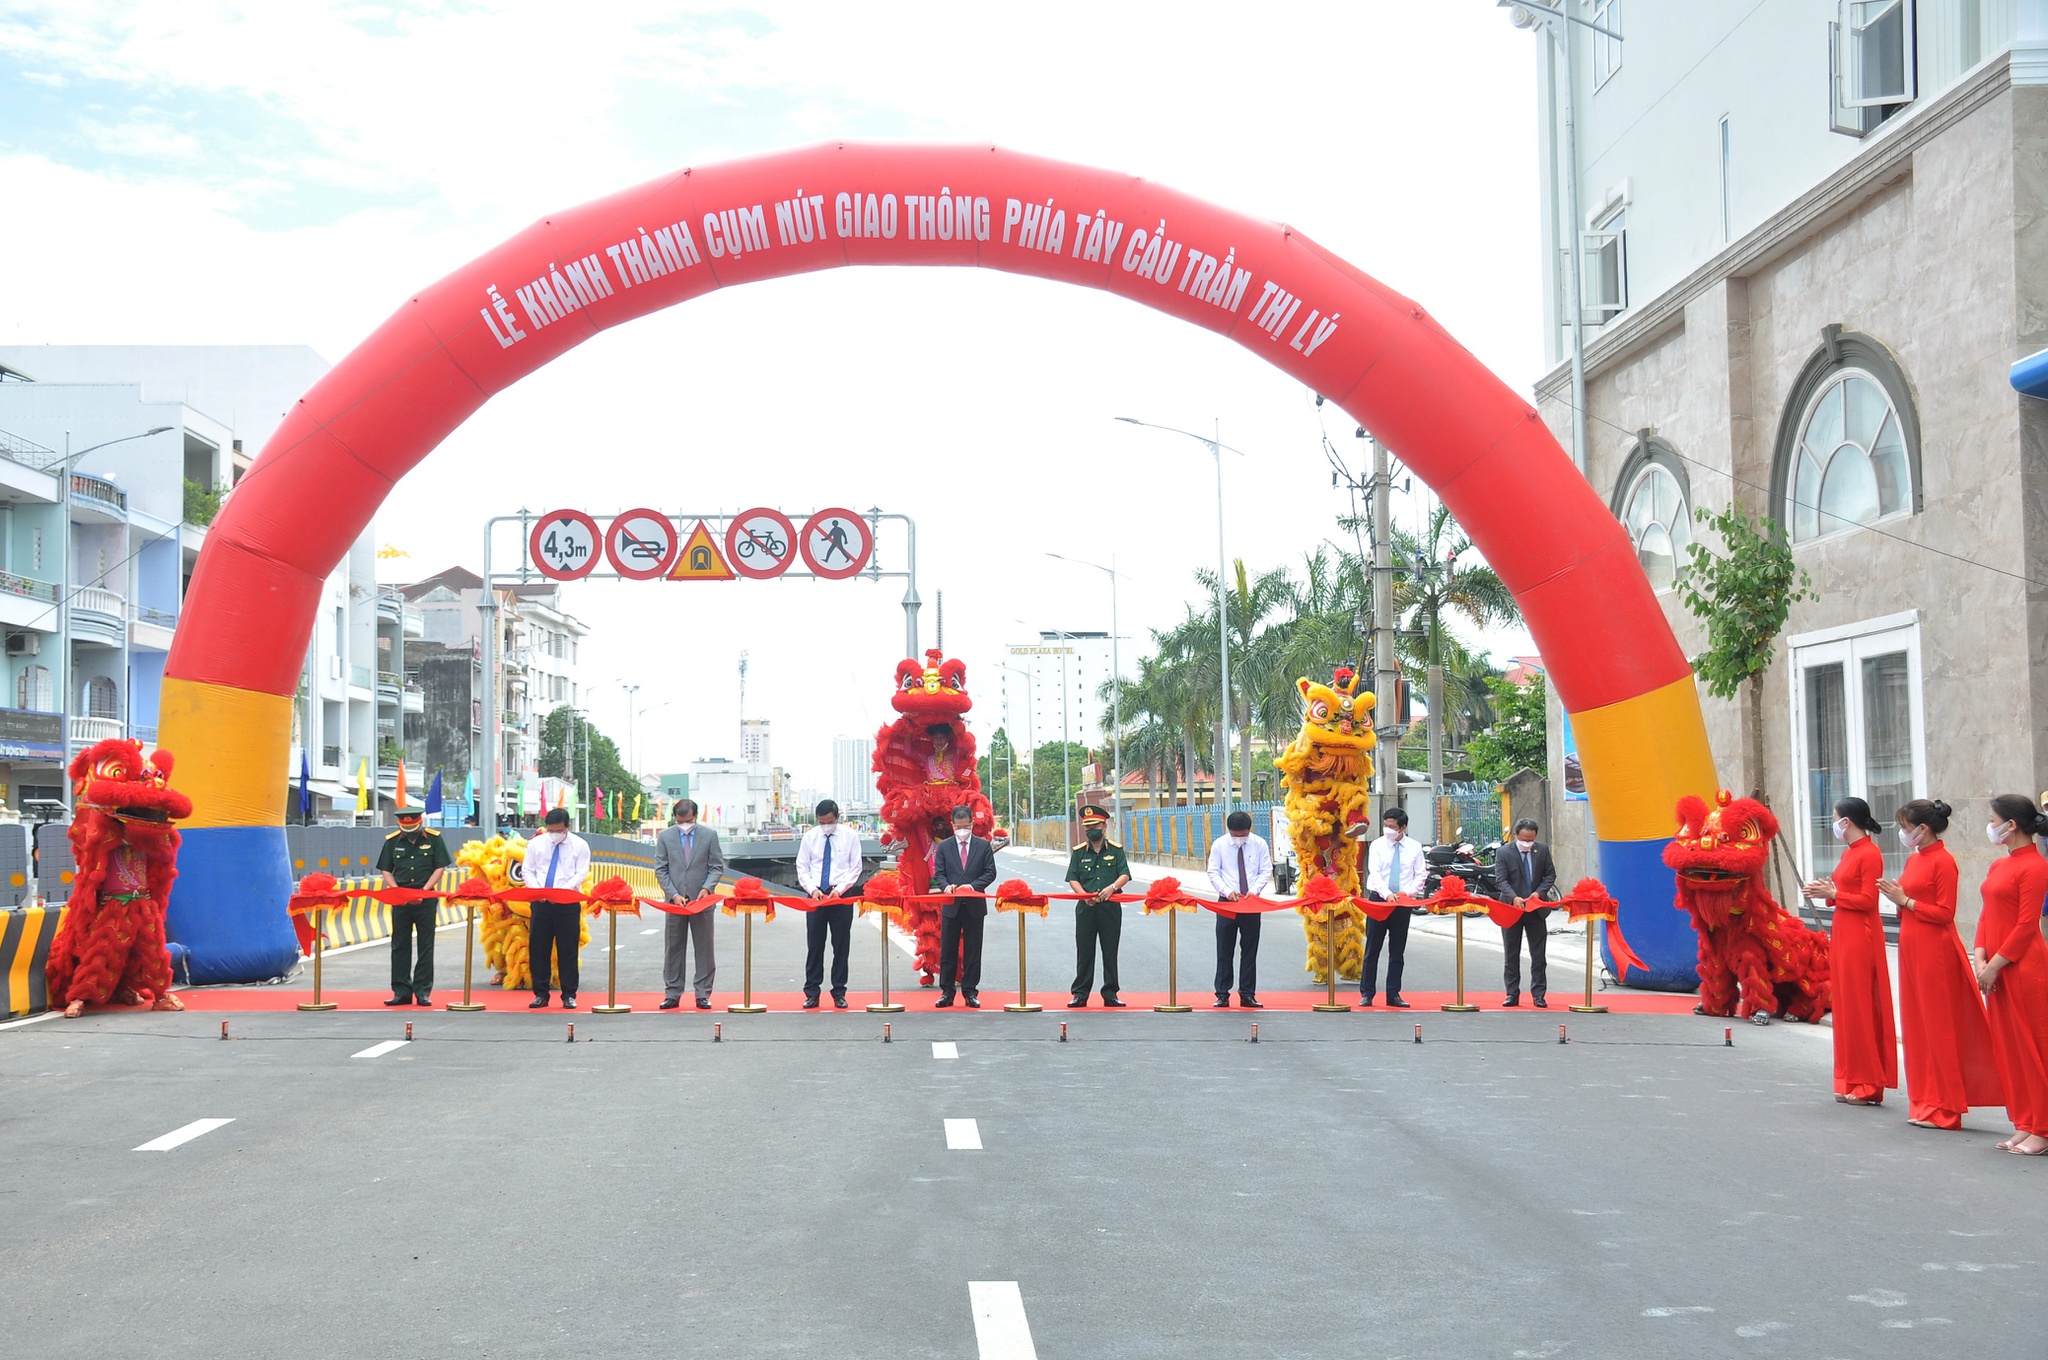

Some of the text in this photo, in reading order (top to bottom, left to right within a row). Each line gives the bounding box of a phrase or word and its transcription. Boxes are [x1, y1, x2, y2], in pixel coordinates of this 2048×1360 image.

[481, 186, 1341, 358] LỄ KHÁNH THÀNH CỤM NÚT GIAO THÔNG PHÍA TÂY CẦU TRẦN THỊ LÝ
[543, 529, 588, 564] 4,3m
[1010, 647, 1029, 655] GOLD
[1029, 647, 1052, 655] PLAZA
